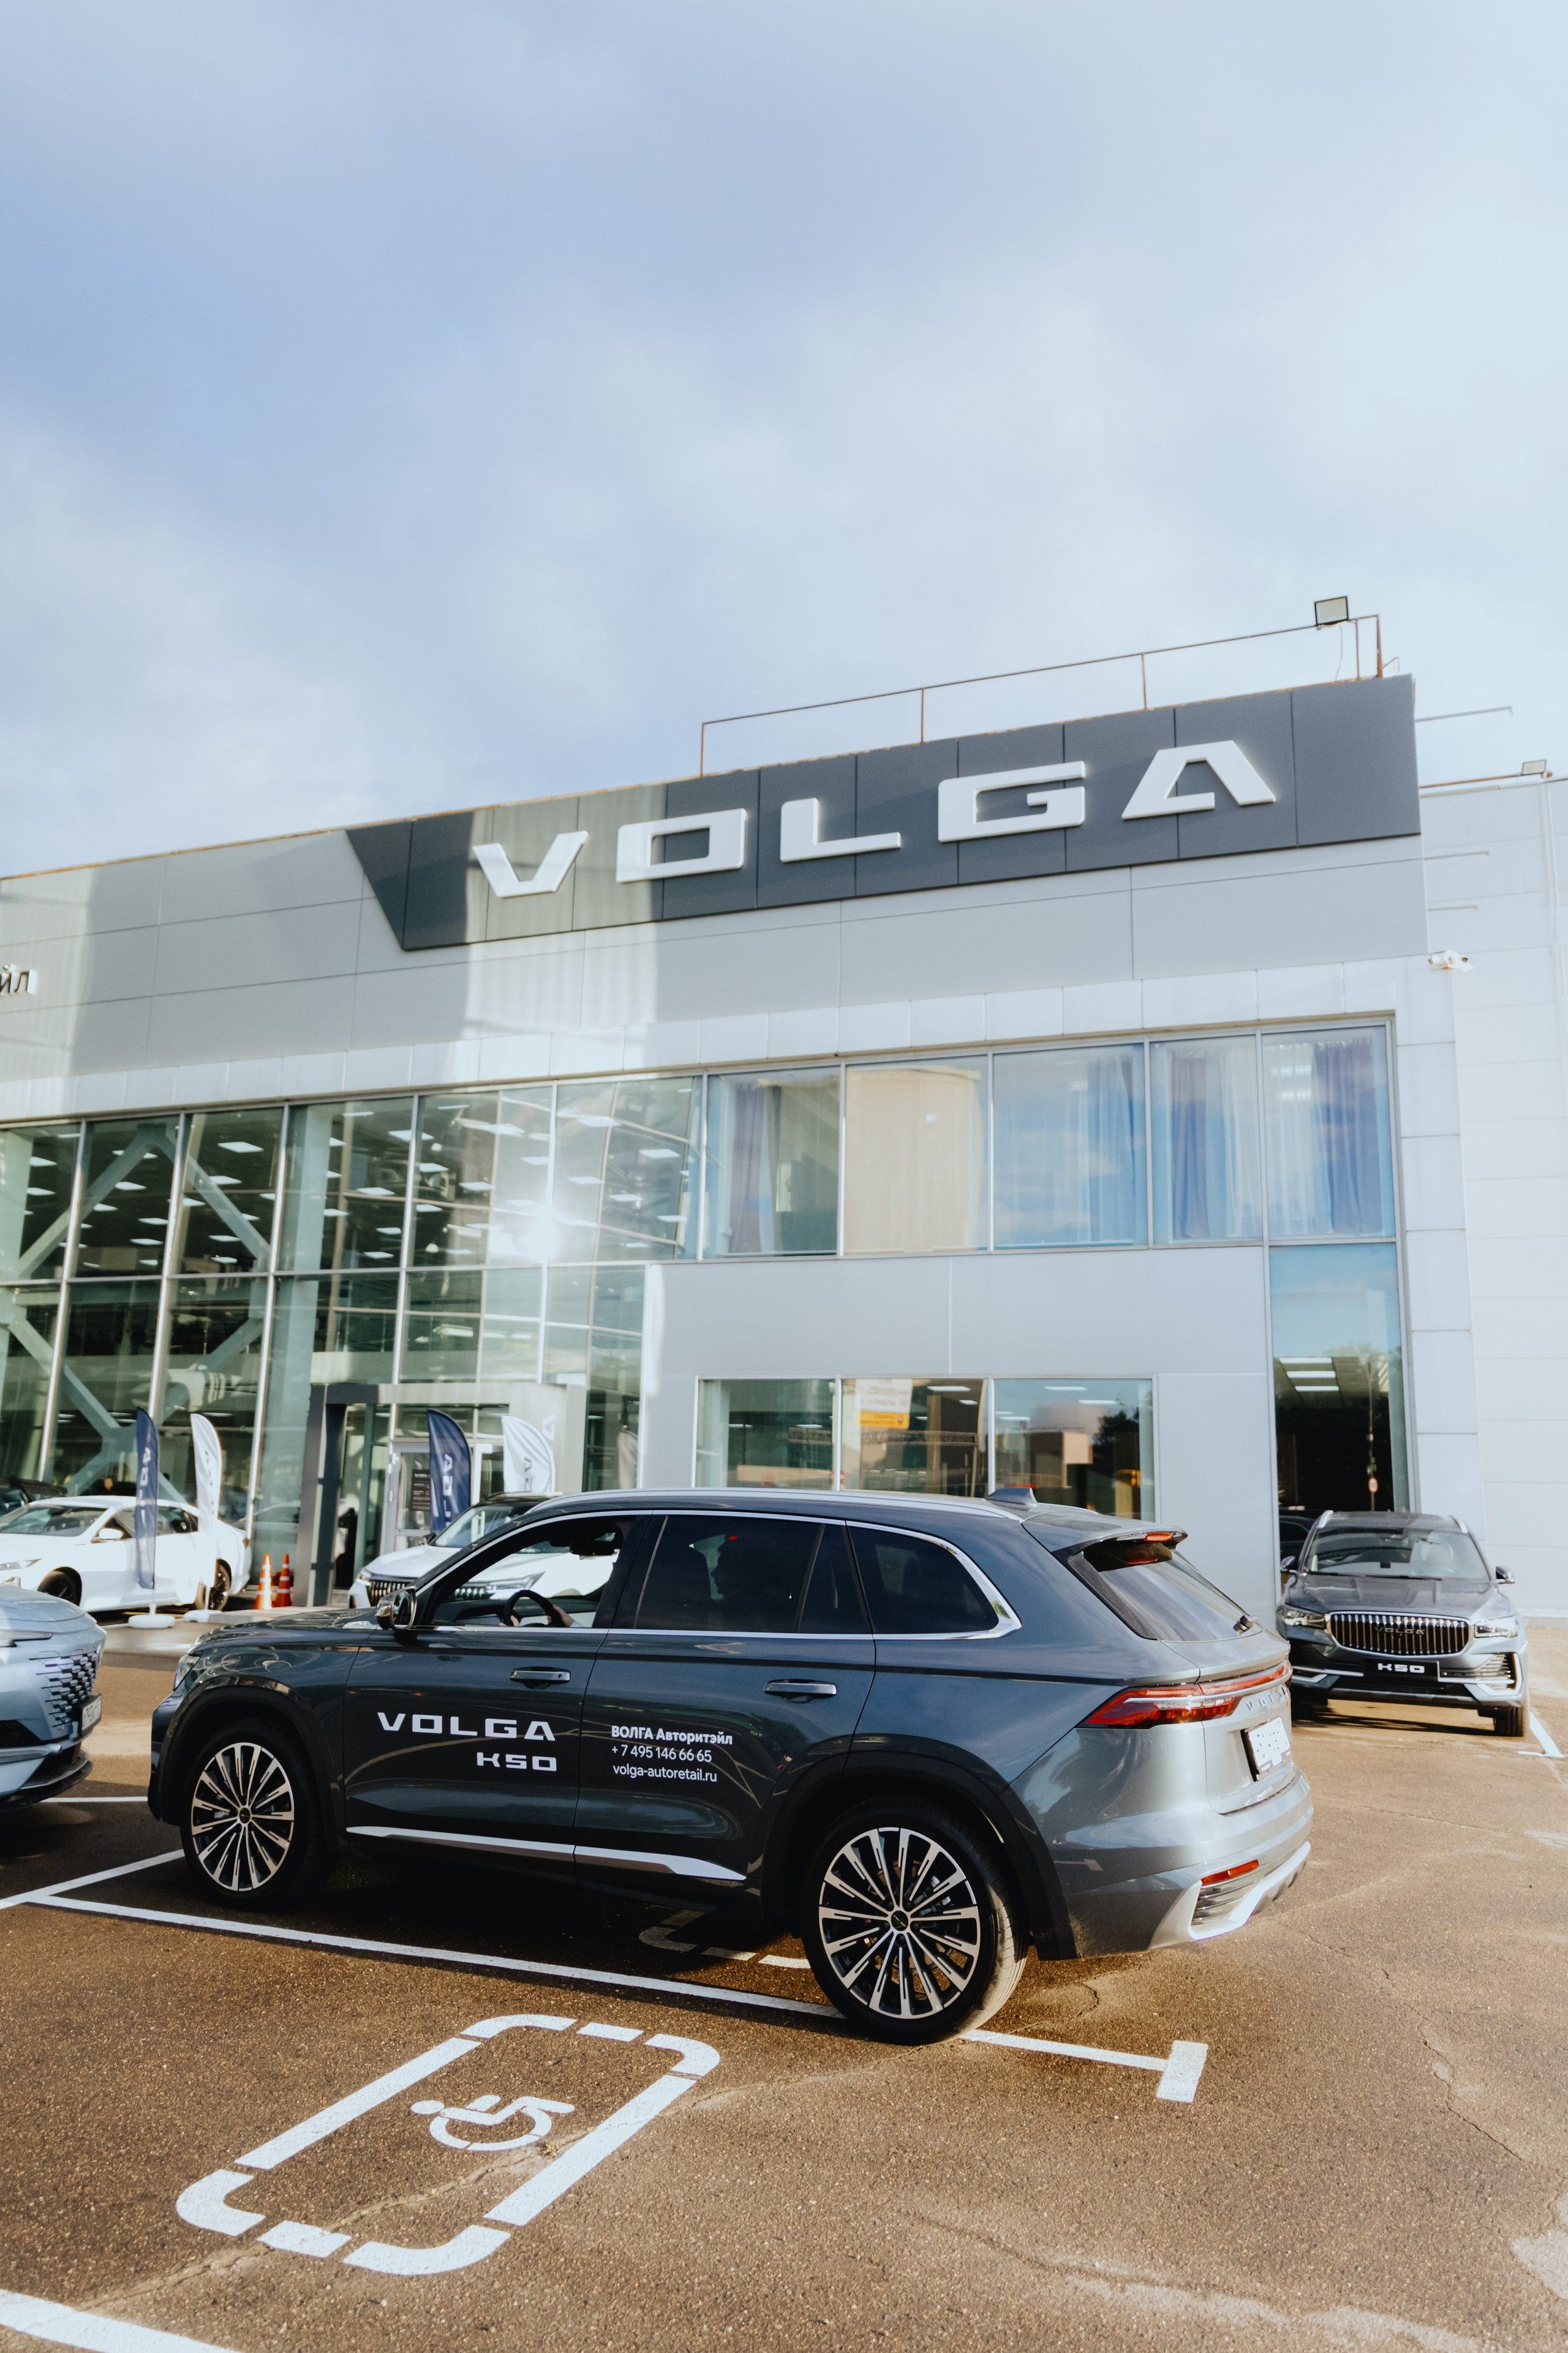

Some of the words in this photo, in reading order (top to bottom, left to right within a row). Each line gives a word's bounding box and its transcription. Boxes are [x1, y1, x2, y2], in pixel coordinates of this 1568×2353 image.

[472, 739, 1277, 898] VOLGA
[1374, 1626, 1425, 1635] VOLGA
[1378, 1663, 1425, 1674] K50
[377, 1712, 556, 1741] VOLGA
[611, 1725, 654, 1740] ВОЛГА
[655, 1728, 733, 1745] Авторитэйл
[477, 1752, 557, 1771] K50
[621, 1744, 628, 1756] 7
[630, 1745, 653, 1758] 495
[655, 1747, 676, 1760] 146
[679, 1748, 695, 1761] 66
[696, 1750, 712, 1762] 65
[612, 1763, 717, 1782] volga-autoretail.ru
